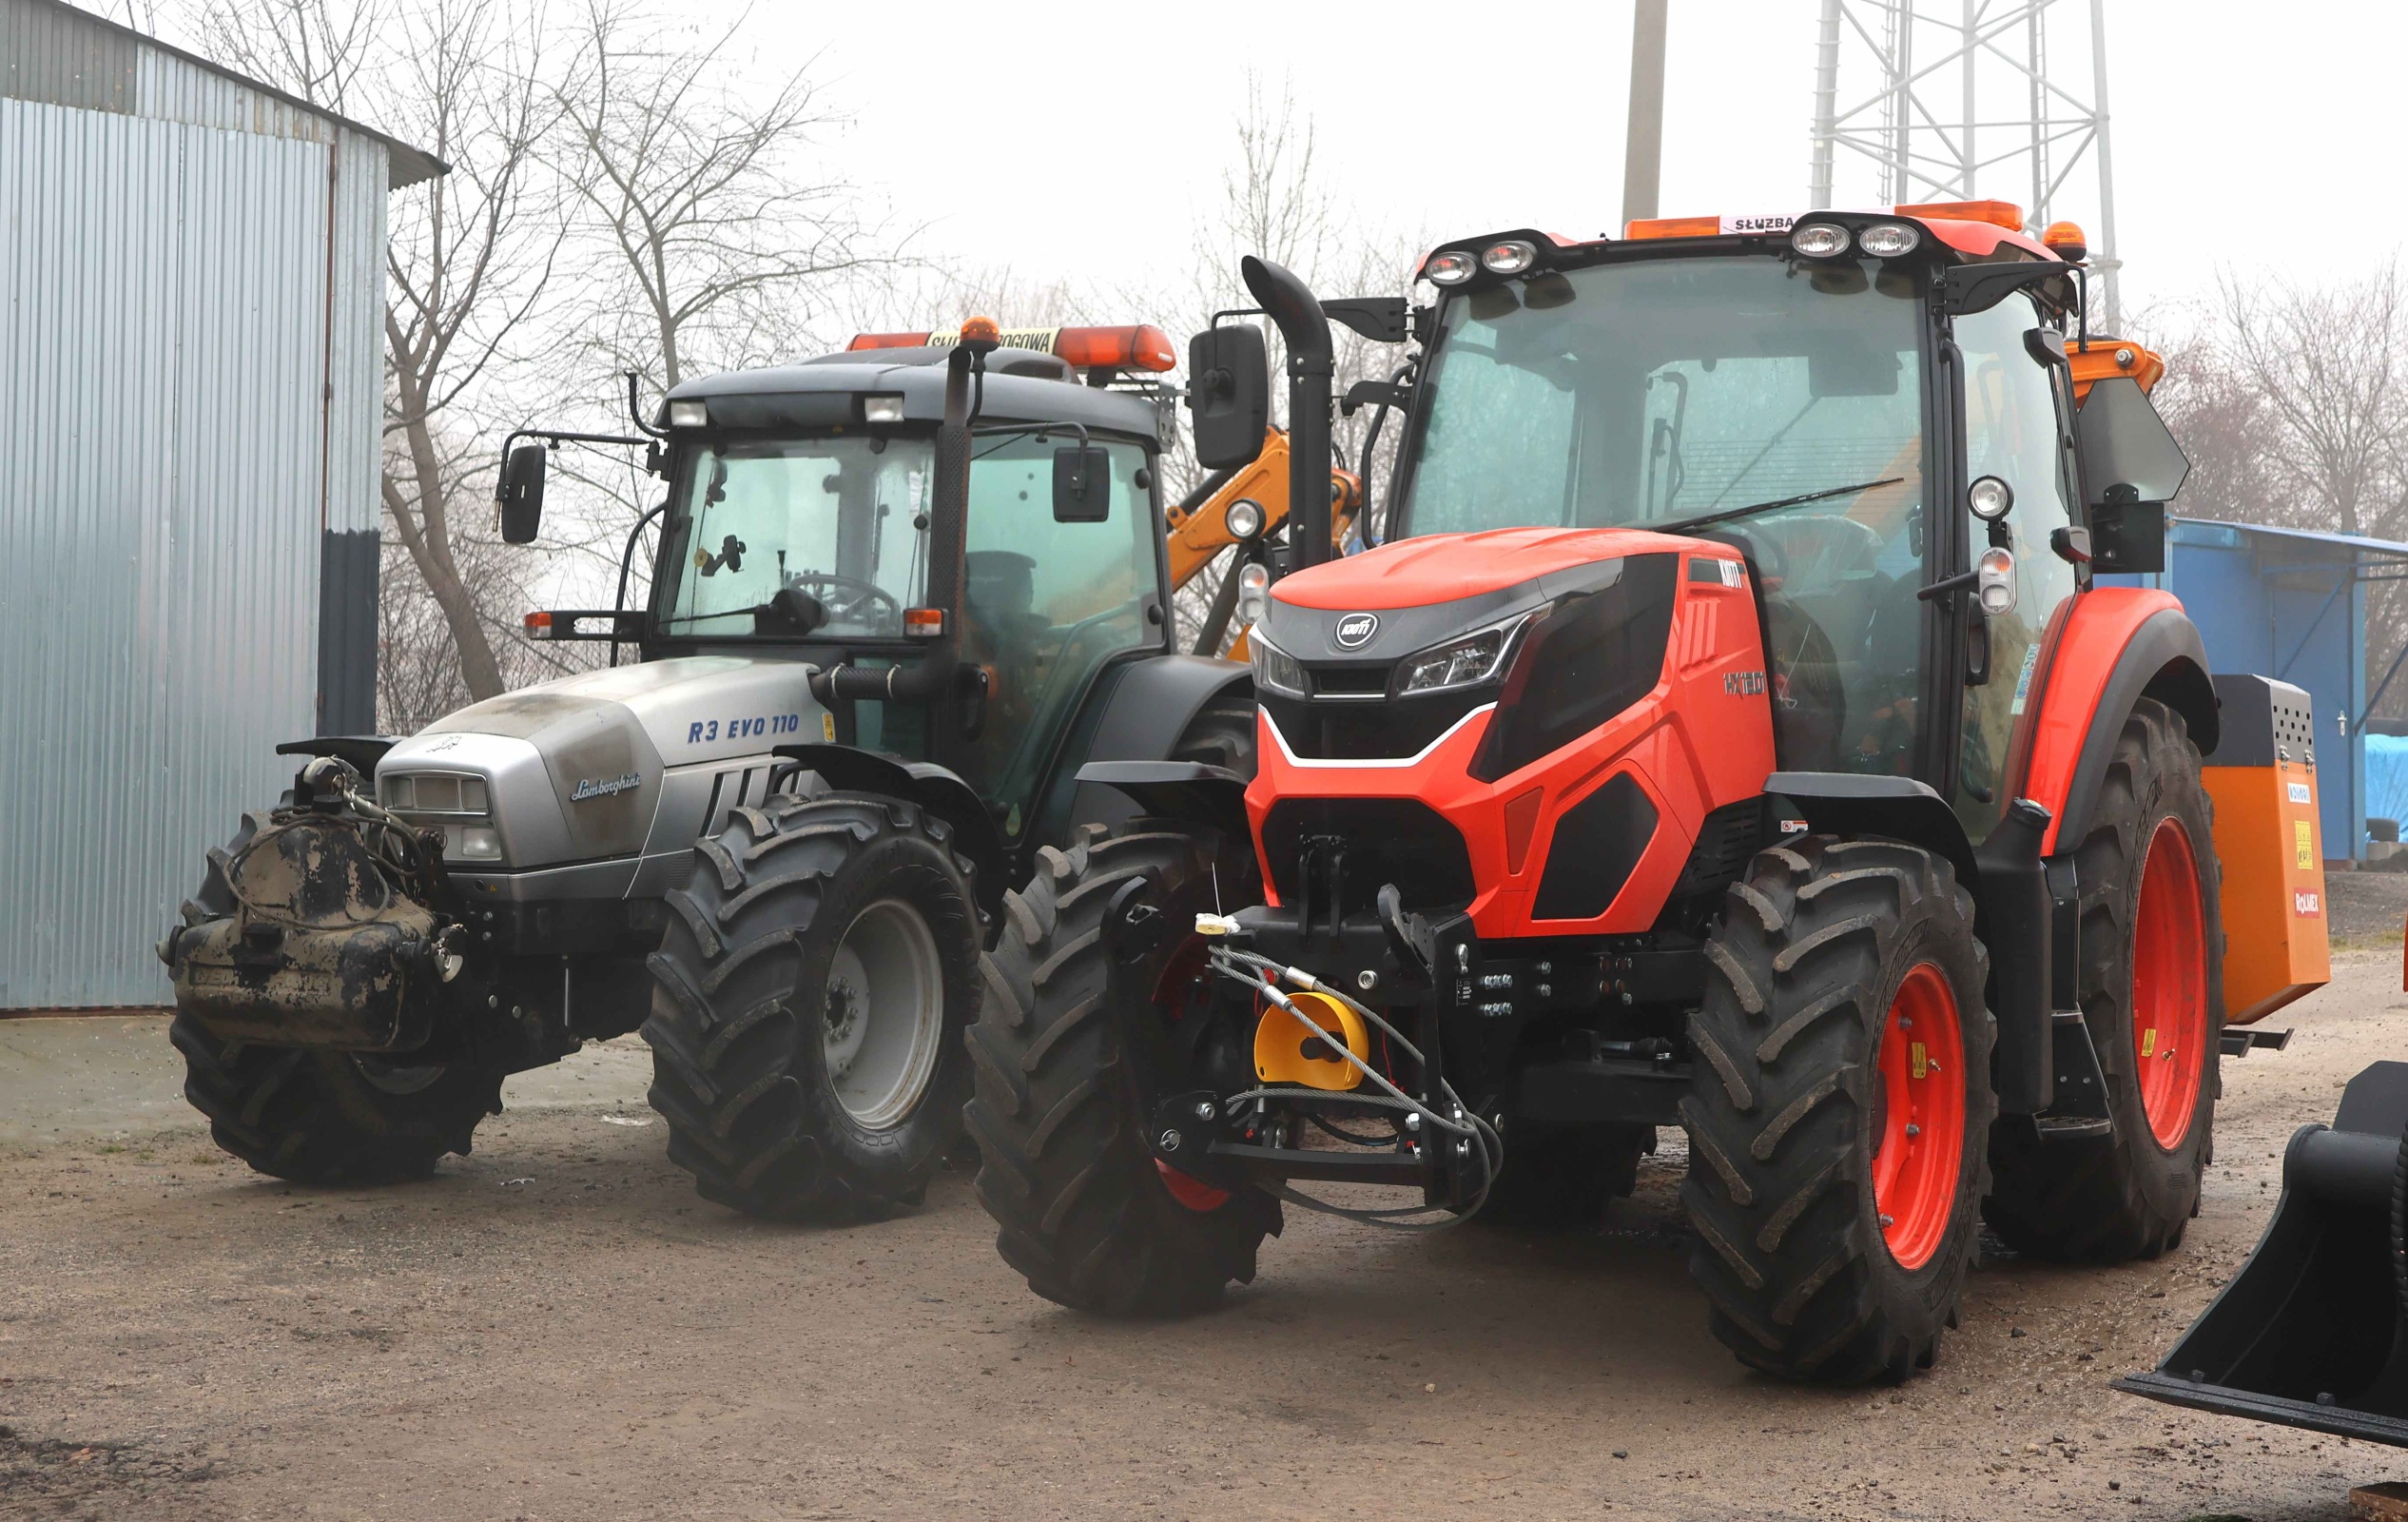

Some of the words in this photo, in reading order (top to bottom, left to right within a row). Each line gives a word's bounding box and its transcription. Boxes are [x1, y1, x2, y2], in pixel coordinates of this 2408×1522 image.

[688, 720, 719, 743] R3
[728, 717, 766, 739] EVO
[771, 714, 799, 734] 110
[571, 772, 641, 801] Lamborghini
